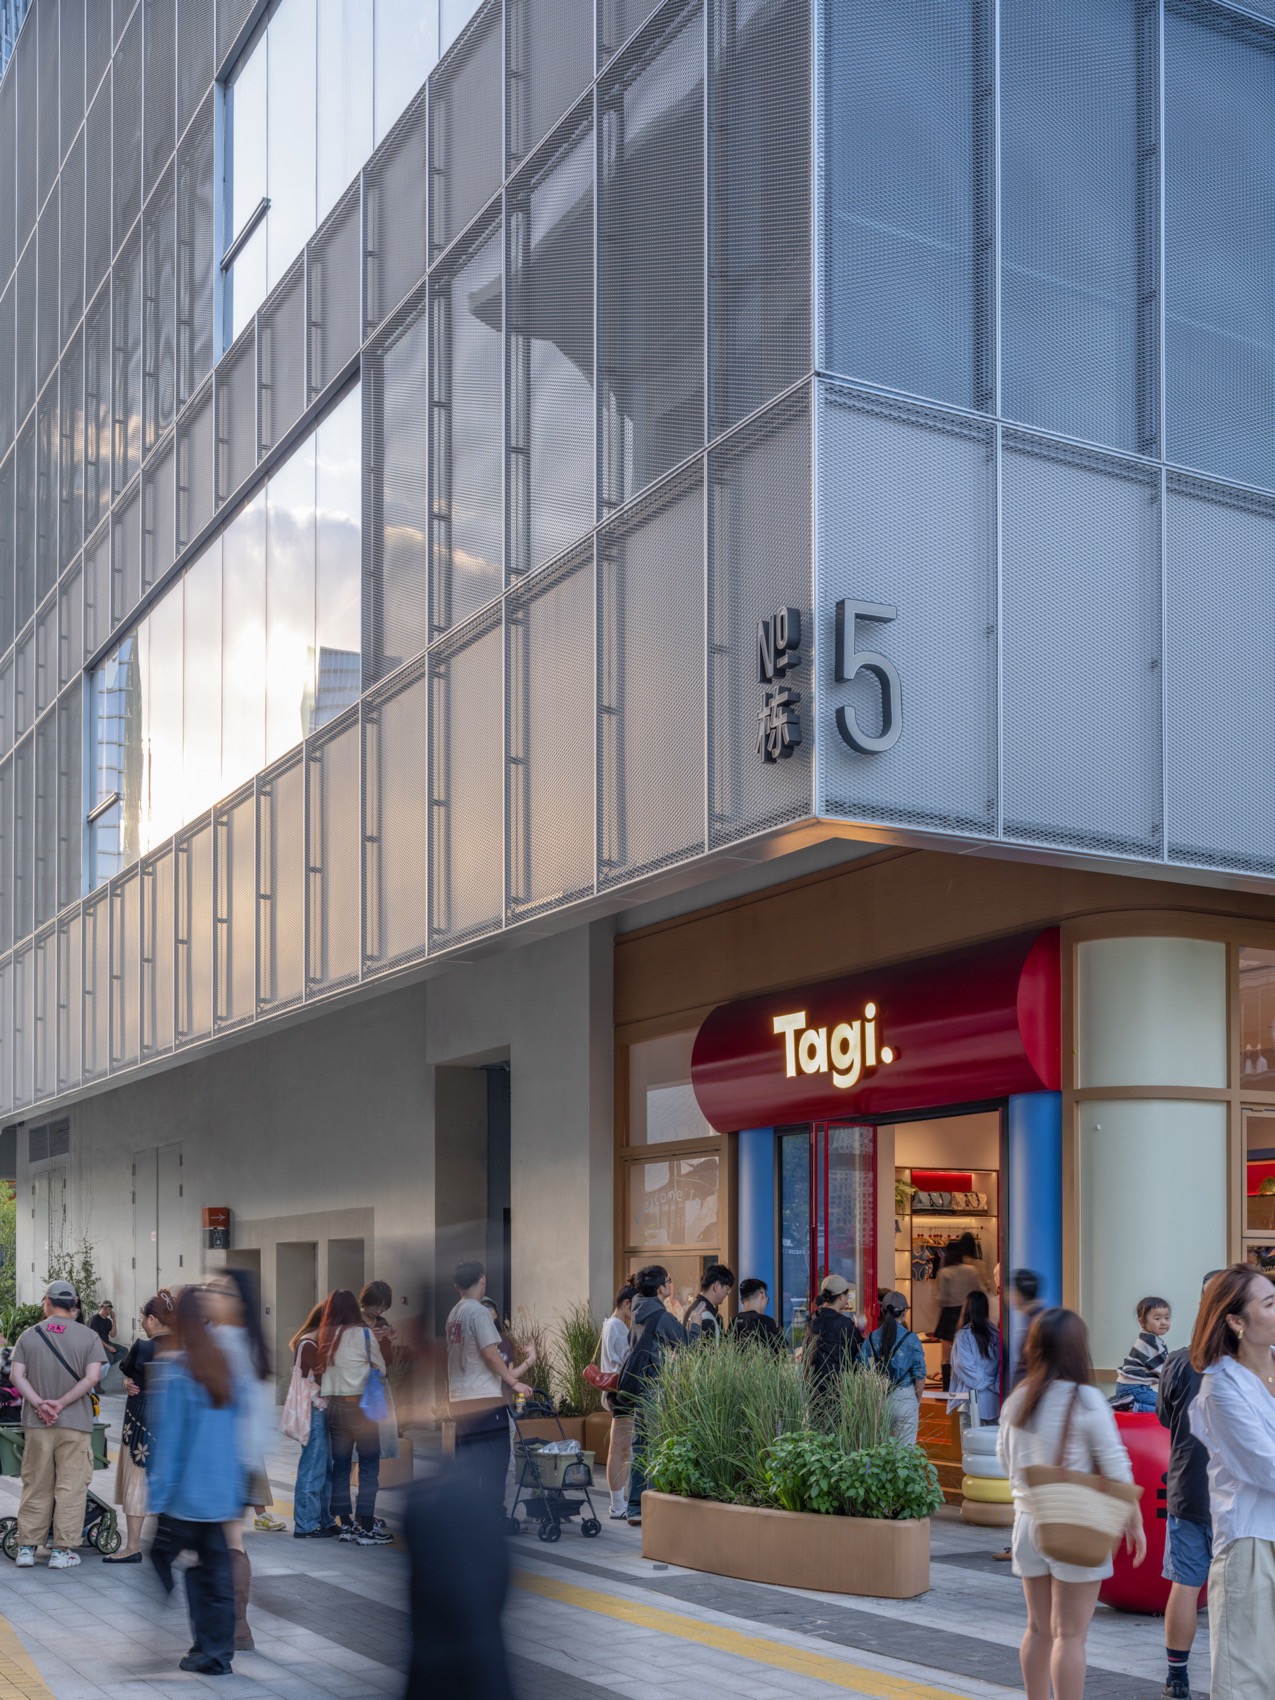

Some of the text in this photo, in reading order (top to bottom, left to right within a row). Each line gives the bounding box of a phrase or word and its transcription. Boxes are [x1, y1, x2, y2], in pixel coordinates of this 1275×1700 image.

[835, 598, 902, 755] 5
[773, 1002, 893, 1089] Tagi.
[46, 1323, 67, 1334] FLY
